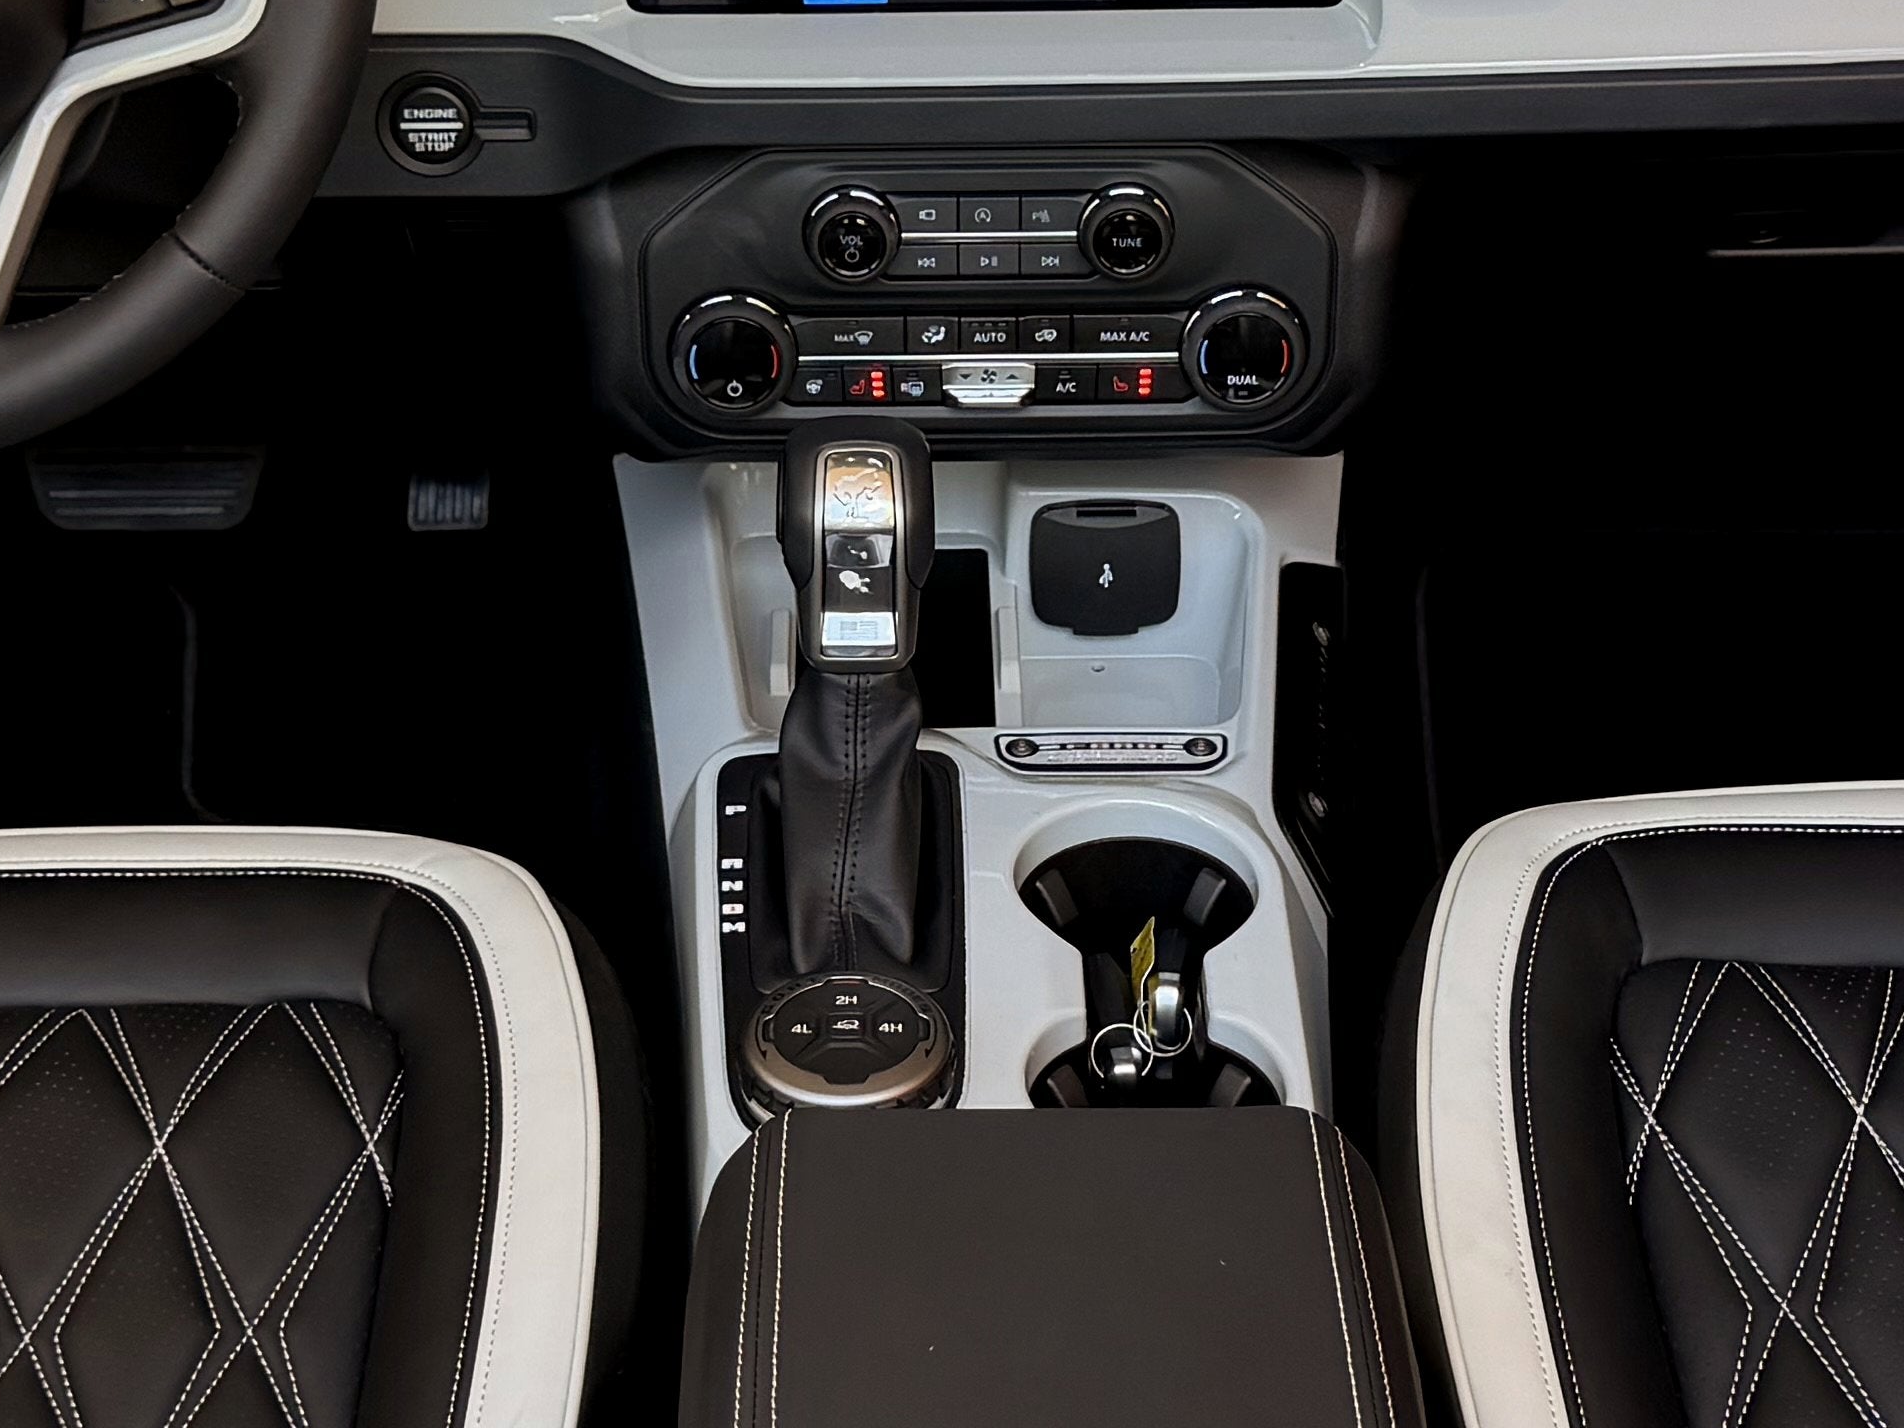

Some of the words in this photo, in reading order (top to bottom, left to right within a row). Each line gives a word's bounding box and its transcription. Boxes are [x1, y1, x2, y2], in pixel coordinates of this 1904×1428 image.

[403, 108, 458, 120] ENGINE
[408, 132, 458, 143] START
[414, 142, 455, 153] STOP
[840, 234, 864, 246] VOL
[1112, 237, 1143, 247] TUNE
[834, 334, 855, 342] MAX
[974, 332, 1007, 343] AUTO
[1100, 331, 1127, 342] MAX
[1129, 331, 1150, 342] A/C
[1227, 375, 1259, 386] DUAL
[1055, 382, 1077, 393] A/C
[721, 880, 743, 891] N
[722, 922, 746, 932] M
[835, 995, 858, 1005] 2H
[791, 1024, 812, 1034] 4L
[878, 1023, 903, 1033] 4H
